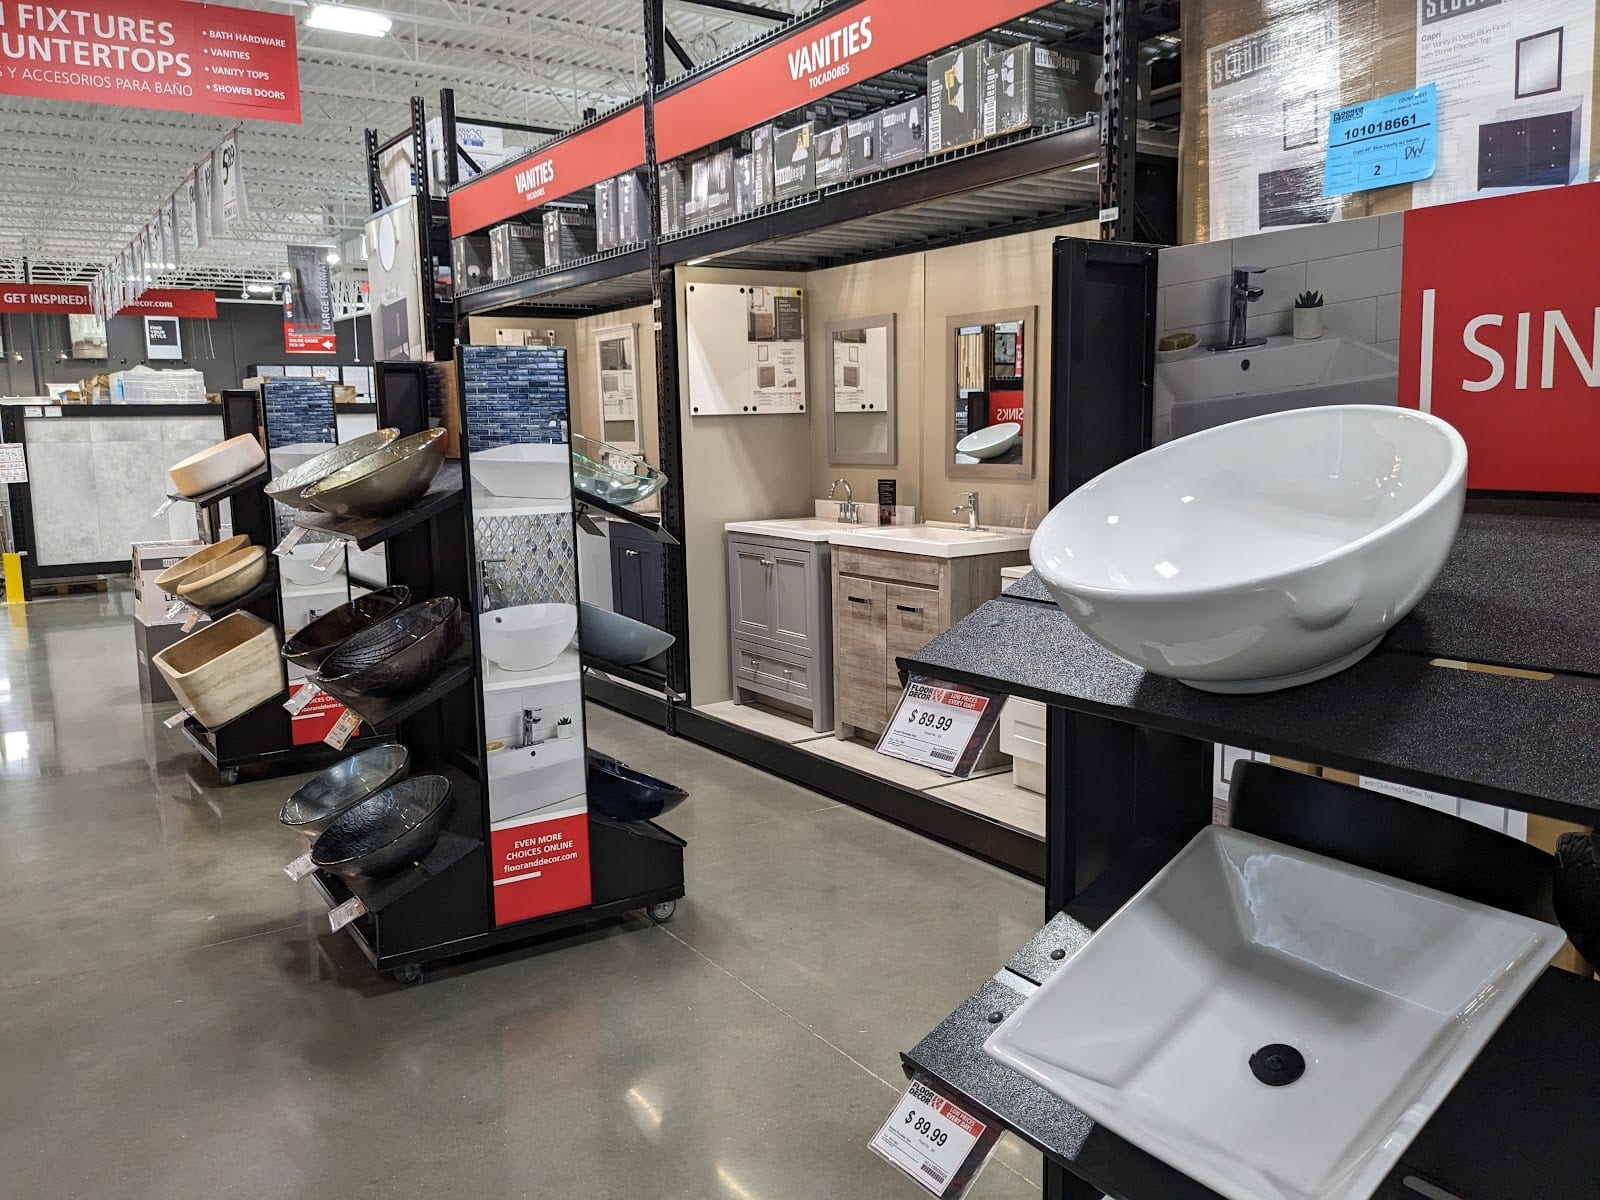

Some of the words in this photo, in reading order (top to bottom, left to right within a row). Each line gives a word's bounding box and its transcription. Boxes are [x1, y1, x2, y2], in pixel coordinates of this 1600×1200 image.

[18, 3, 175, 47] FIXTURES
[209, 30, 233, 41] BATH
[235, 33, 286, 48] HARDWARE
[1421, 30, 1442, 42] Capri
[1458, 33, 1475, 41] Deep
[2, 32, 192, 77] UNTERTOPS
[210, 47, 251, 60] VANITIES
[787, 16, 872, 81] VANITIES
[1434, 47, 1452, 57] Stone
[1480, 37, 1492, 45] Top
[7, 66, 17, 78] Y
[22, 68, 112, 89] ACCESORIOS
[116, 78, 151, 93] PARA
[155, 80, 193, 97] BAÑO
[211, 65, 244, 77] VANITY
[246, 70, 269, 81] TOPS
[808, 62, 850, 89] TOCADORES
[213, 84, 252, 96] SHOWER
[254, 88, 286, 100] DOORS
[1345, 113, 1416, 140] 101018661
[514, 159, 554, 195] VANITIES
[1374, 165, 1381, 176] 2
[319, 260, 329, 299] FORMAT
[4, 292, 26, 304] GET
[30, 293, 88, 306] INSPIRED!
[320, 300, 331, 330] LARGE
[1462, 307, 1600, 393] SIN
[908, 690, 932, 701] DECOR
[911, 684, 933, 695] FLOOR
[950, 692, 961, 700] LOW
[961, 695, 978, 704] PRICES
[948, 699, 963, 708] EVERY
[963, 702, 976, 710] DAY!
[908, 708, 918, 723] $
[918, 712, 953, 731] 89.99
[1424, 791, 1435, 800] Top
[506, 847, 542, 861] CHOICES
[543, 840, 574, 853] ONLINE
[514, 837, 536, 849] EVEN
[538, 832, 563, 844] MORE
[503, 852, 578, 873] flooranddecor.com
[908, 1087, 931, 1106] DECOR
[912, 1081, 935, 1100] FLOOR
[946, 1111, 962, 1127] EVERY
[960, 1120, 973, 1133] DAY!
[949, 1106, 960, 1116] LOW
[958, 1111, 976, 1128] PRICES
[904, 1110, 916, 1125] $
[914, 1117, 948, 1147] 89.99
